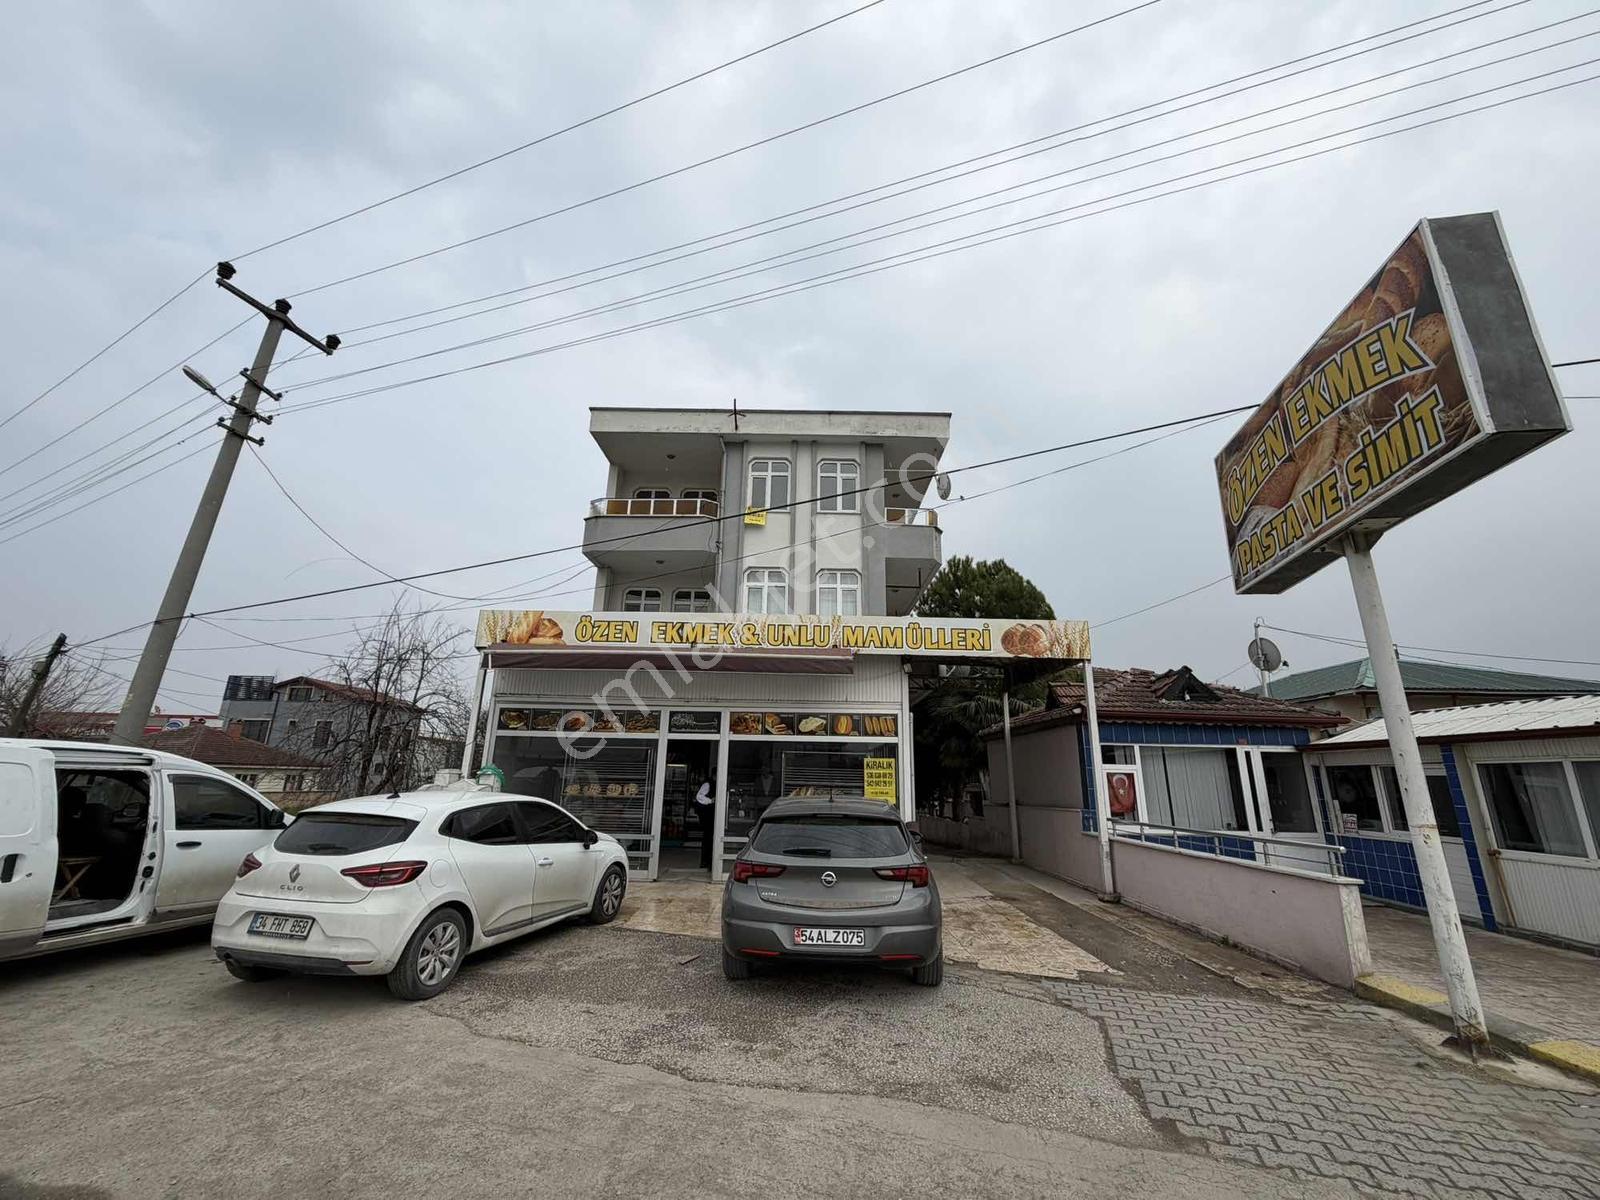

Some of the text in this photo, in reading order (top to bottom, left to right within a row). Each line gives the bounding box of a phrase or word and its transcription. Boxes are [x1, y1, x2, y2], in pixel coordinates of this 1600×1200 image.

[1228, 311, 1433, 525] ÖZEN EKMEK
[1237, 388, 1444, 577] PASTA VE SİMİT
[575, 615, 992, 651] ÖZEN EKMEK & UNLU MAMÜLLERİ
[279, 884, 304, 892] CLIO
[256, 915, 309, 934] 34 FHT 858
